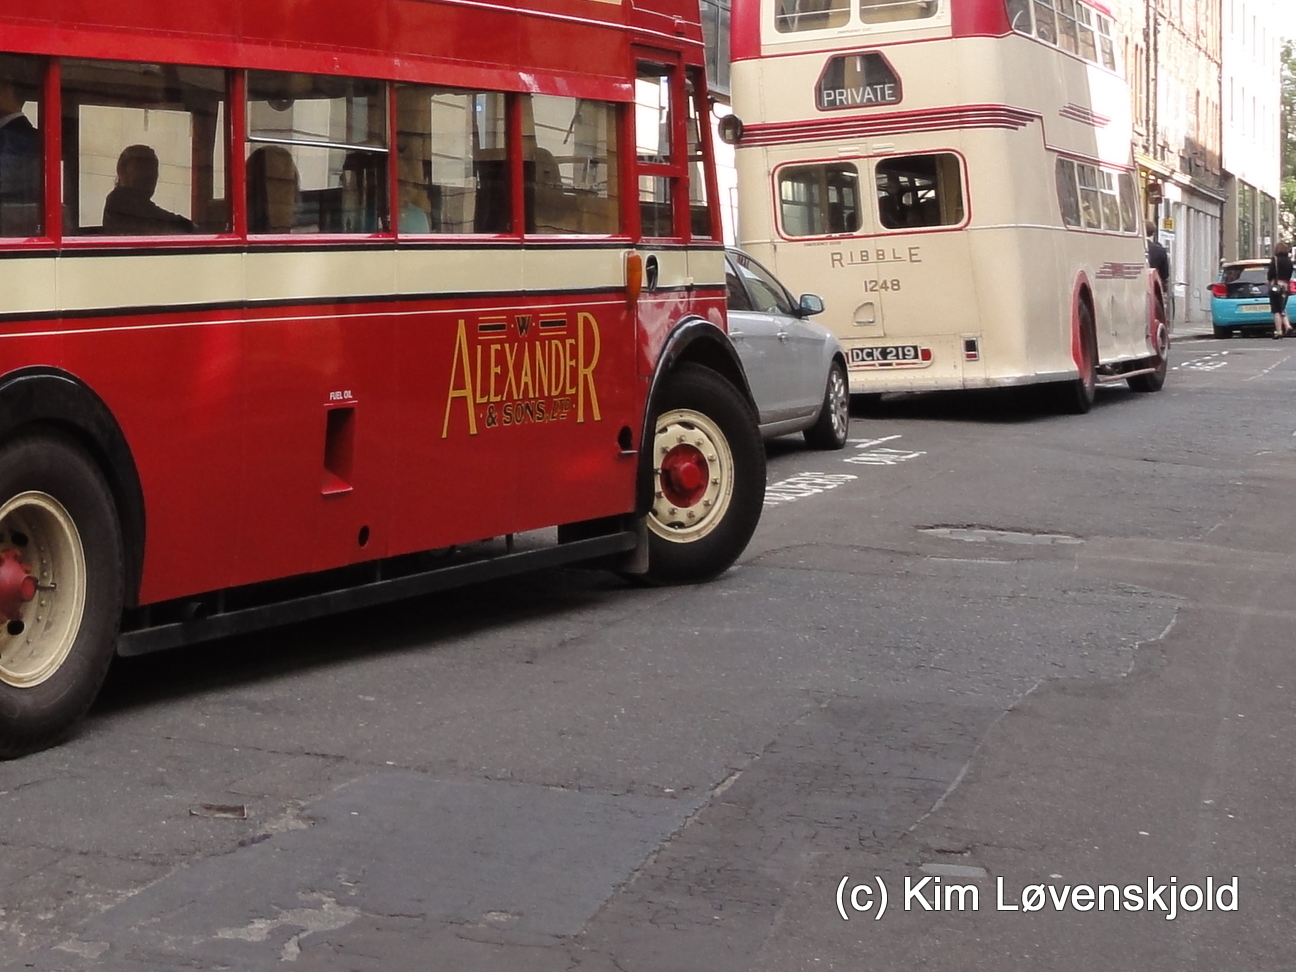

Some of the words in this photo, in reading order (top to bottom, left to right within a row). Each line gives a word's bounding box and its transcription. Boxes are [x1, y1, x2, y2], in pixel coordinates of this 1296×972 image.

[824, 84, 896, 107] PRIVATE
[831, 247, 922, 269] RIBBLE
[864, 279, 901, 292] 1248
[853, 348, 885, 361] DCK
[887, 347, 915, 360] 219
[441, 312, 601, 439] ALEXANDER
[329, 391, 343, 400] FUEL
[344, 390, 353, 399] OIL
[486, 404, 498, 428] &
